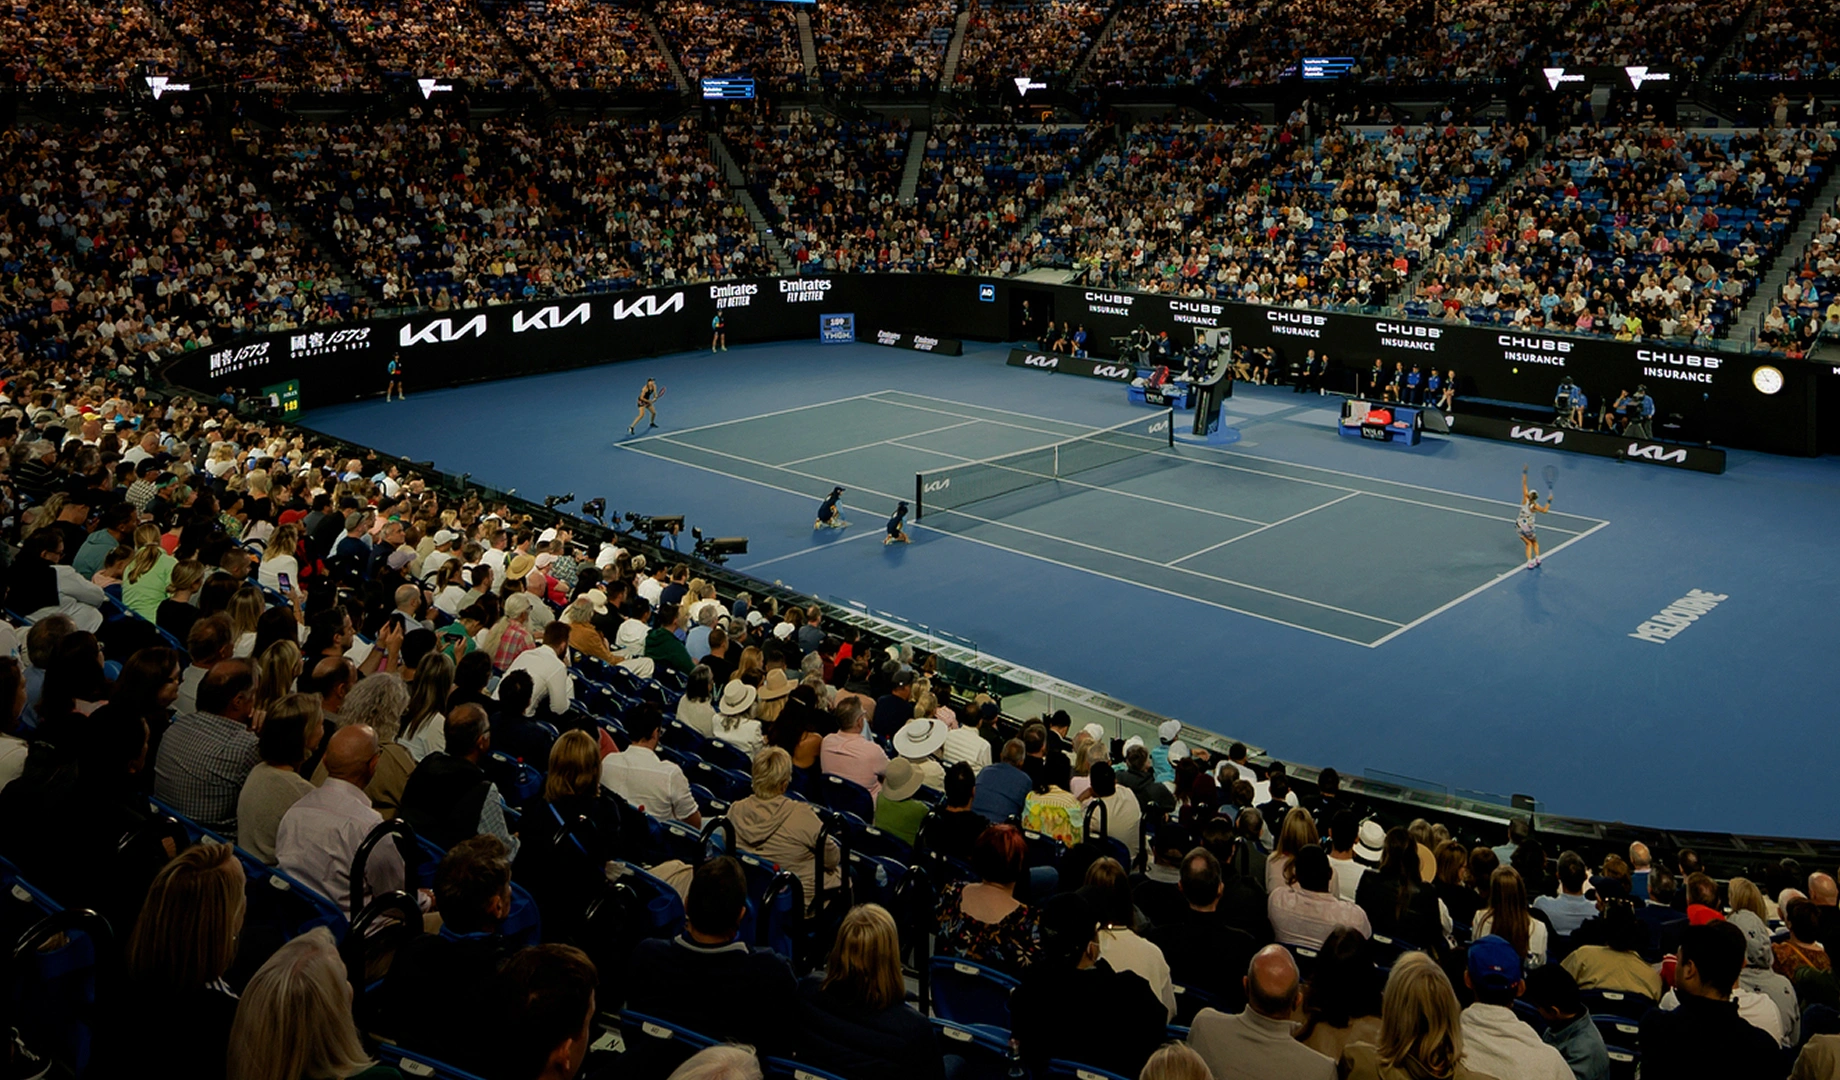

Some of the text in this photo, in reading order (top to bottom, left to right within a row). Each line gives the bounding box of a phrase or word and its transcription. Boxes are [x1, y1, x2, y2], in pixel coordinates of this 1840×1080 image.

[710, 283, 758, 299] Emirates
[779, 278, 832, 293] Emirates
[1085, 291, 1133, 306] CHUBB
[1089, 304, 1130, 317] INSURANCE
[1169, 300, 1222, 315] CHUBB
[1173, 314, 1219, 327] INSURANCE
[1267, 311, 1325, 326] CHUBB
[1272, 325, 1321, 339] INSURANCE
[1376, 322, 1441, 339] CHUBB
[1381, 337, 1436, 352] INSURANCE
[1498, 335, 1572, 353] CHUBB
[1504, 351, 1566, 367] INSURANCE
[1636, 349, 1720, 369] CHUBB
[1643, 366, 1714, 384] INSURANCE
[1362, 427, 1385, 436] POLO
[1627, 587, 1730, 645] MELBOURNE
